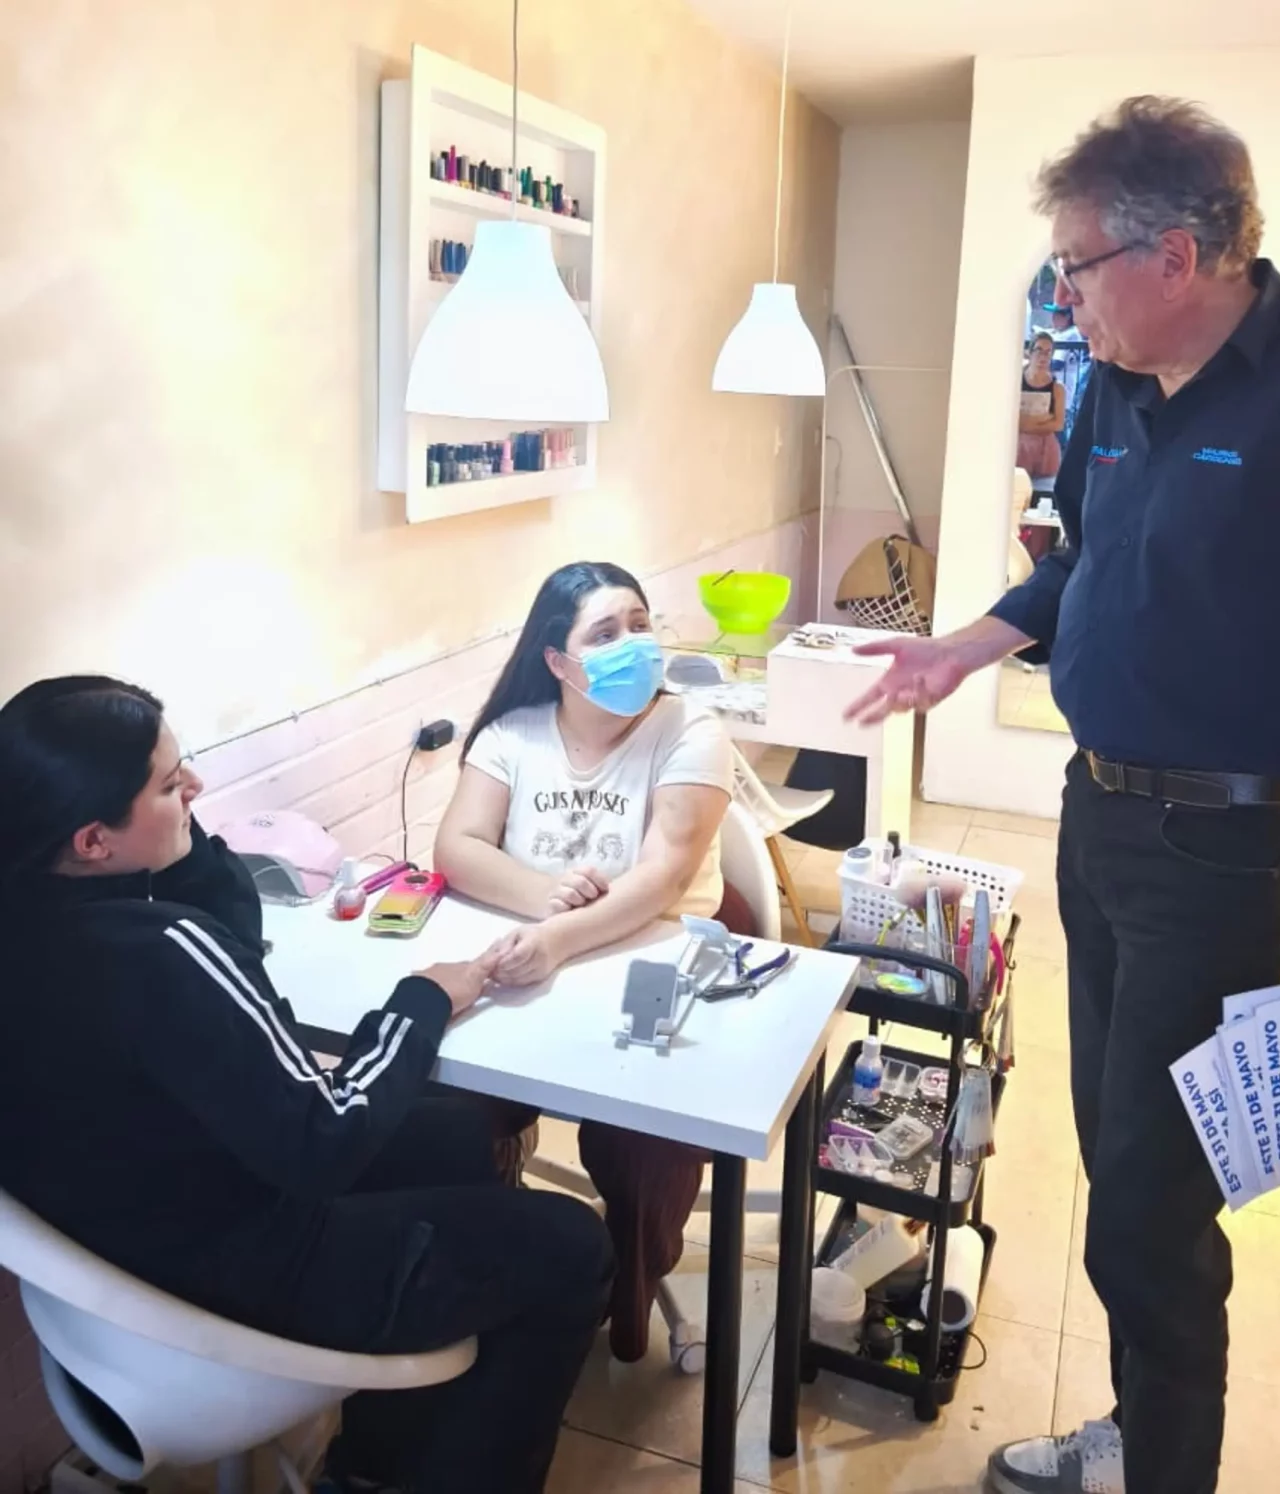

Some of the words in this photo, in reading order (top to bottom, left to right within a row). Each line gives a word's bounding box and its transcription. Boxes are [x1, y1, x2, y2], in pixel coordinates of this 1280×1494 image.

[1233, 1041, 1256, 1090] MAYO
[1182, 1071, 1208, 1117] MAYO
[1247, 1091, 1263, 1117] DE
[1202, 1116, 1218, 1140] DE
[1253, 1117, 1268, 1135] 31
[1211, 1139, 1226, 1155] 31
[1258, 1135, 1275, 1175] ESTE
[1218, 1155, 1242, 1193] ESTE
